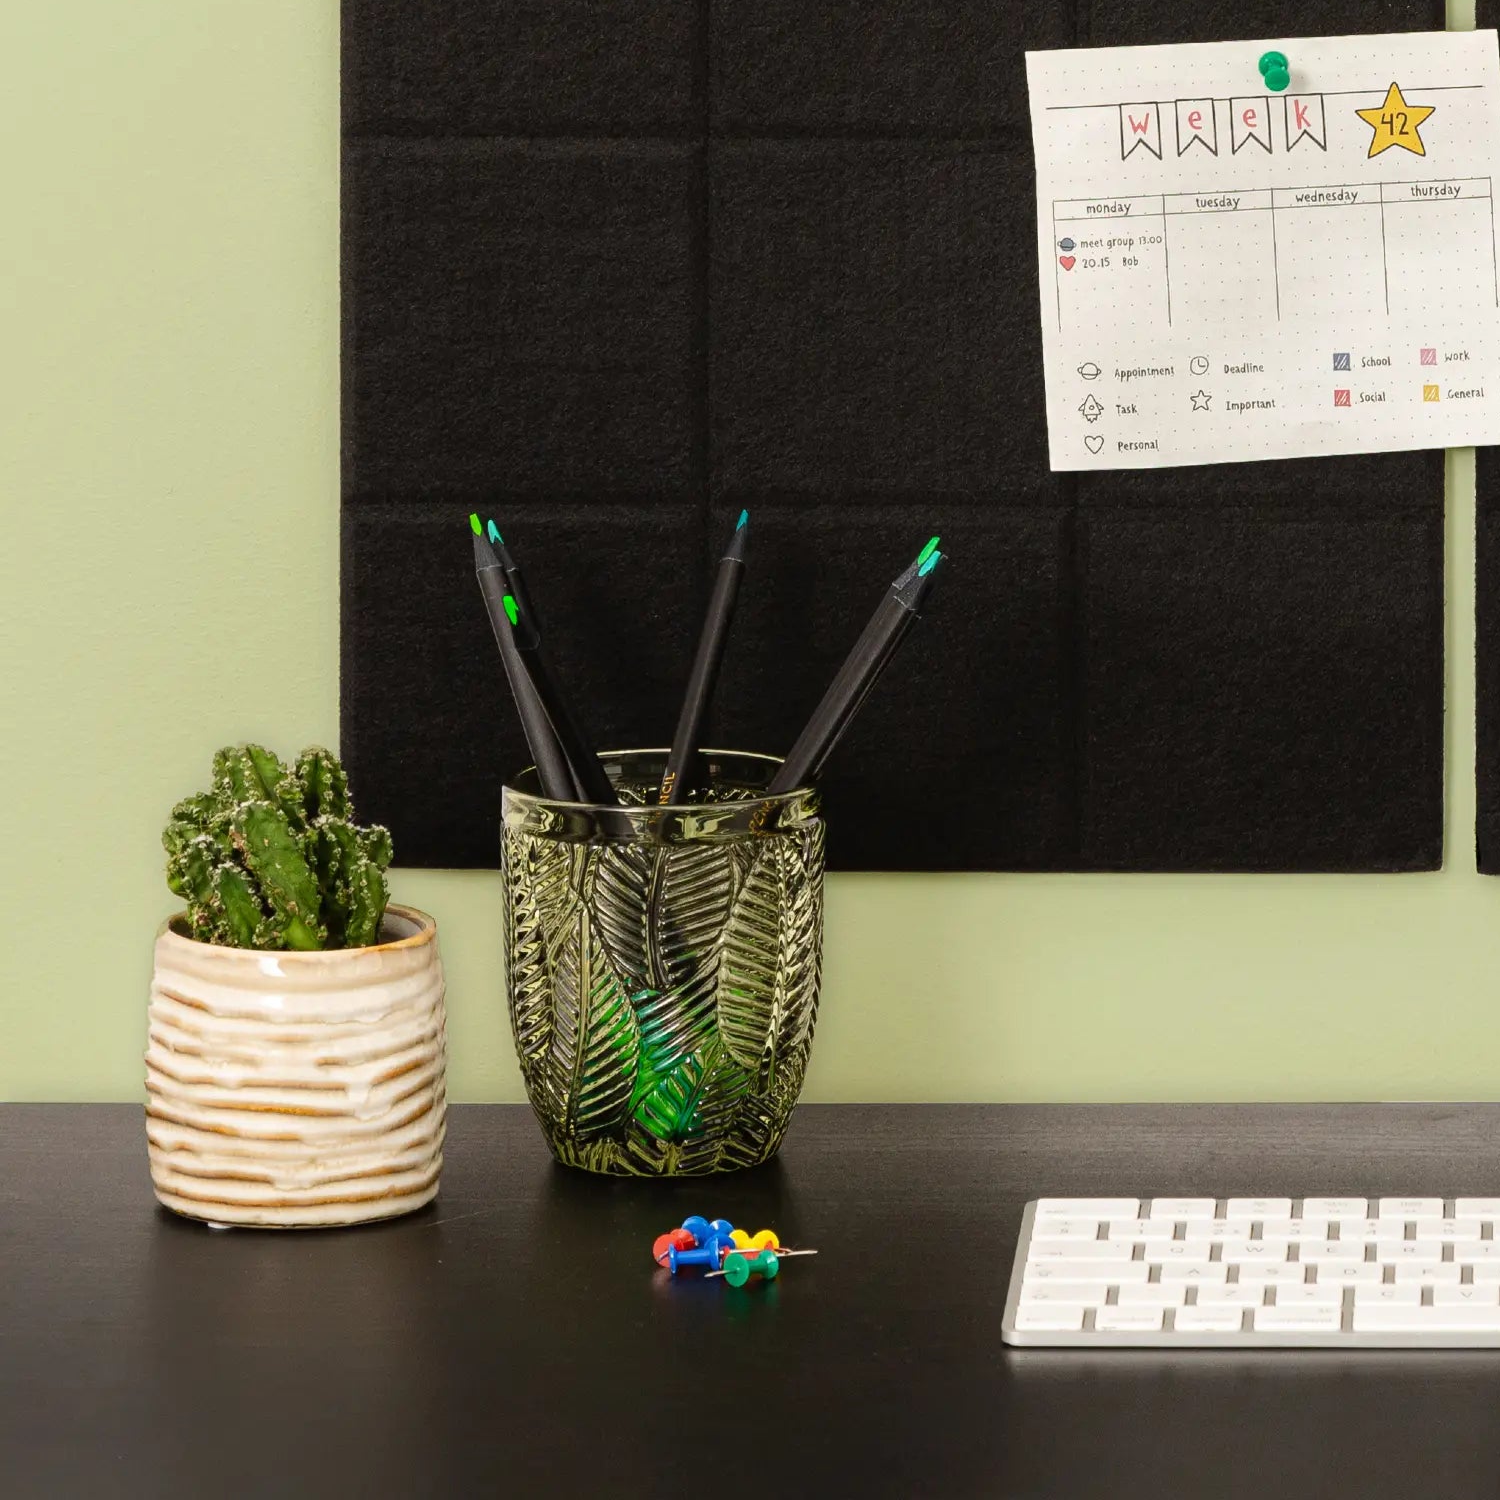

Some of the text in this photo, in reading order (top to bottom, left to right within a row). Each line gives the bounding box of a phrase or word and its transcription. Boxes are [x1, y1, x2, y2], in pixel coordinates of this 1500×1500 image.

[1380, 112, 1410, 137] 42
[1086, 182, 1461, 216] monday tuesday wednesday thursday
[1080, 235, 1163, 252] meet group 13.00
[1081, 256, 1139, 269] 20.15 Bob
[1223, 362, 1265, 374] Deadline
[1361, 355, 1391, 368] School
[1114, 366, 1175, 383] Appointment
[1359, 391, 1386, 404] Social
[1447, 387, 1485, 400] General
[1115, 403, 1138, 415] Task
[1225, 398, 1276, 415] Important
[1117, 439, 1160, 451] Personal
